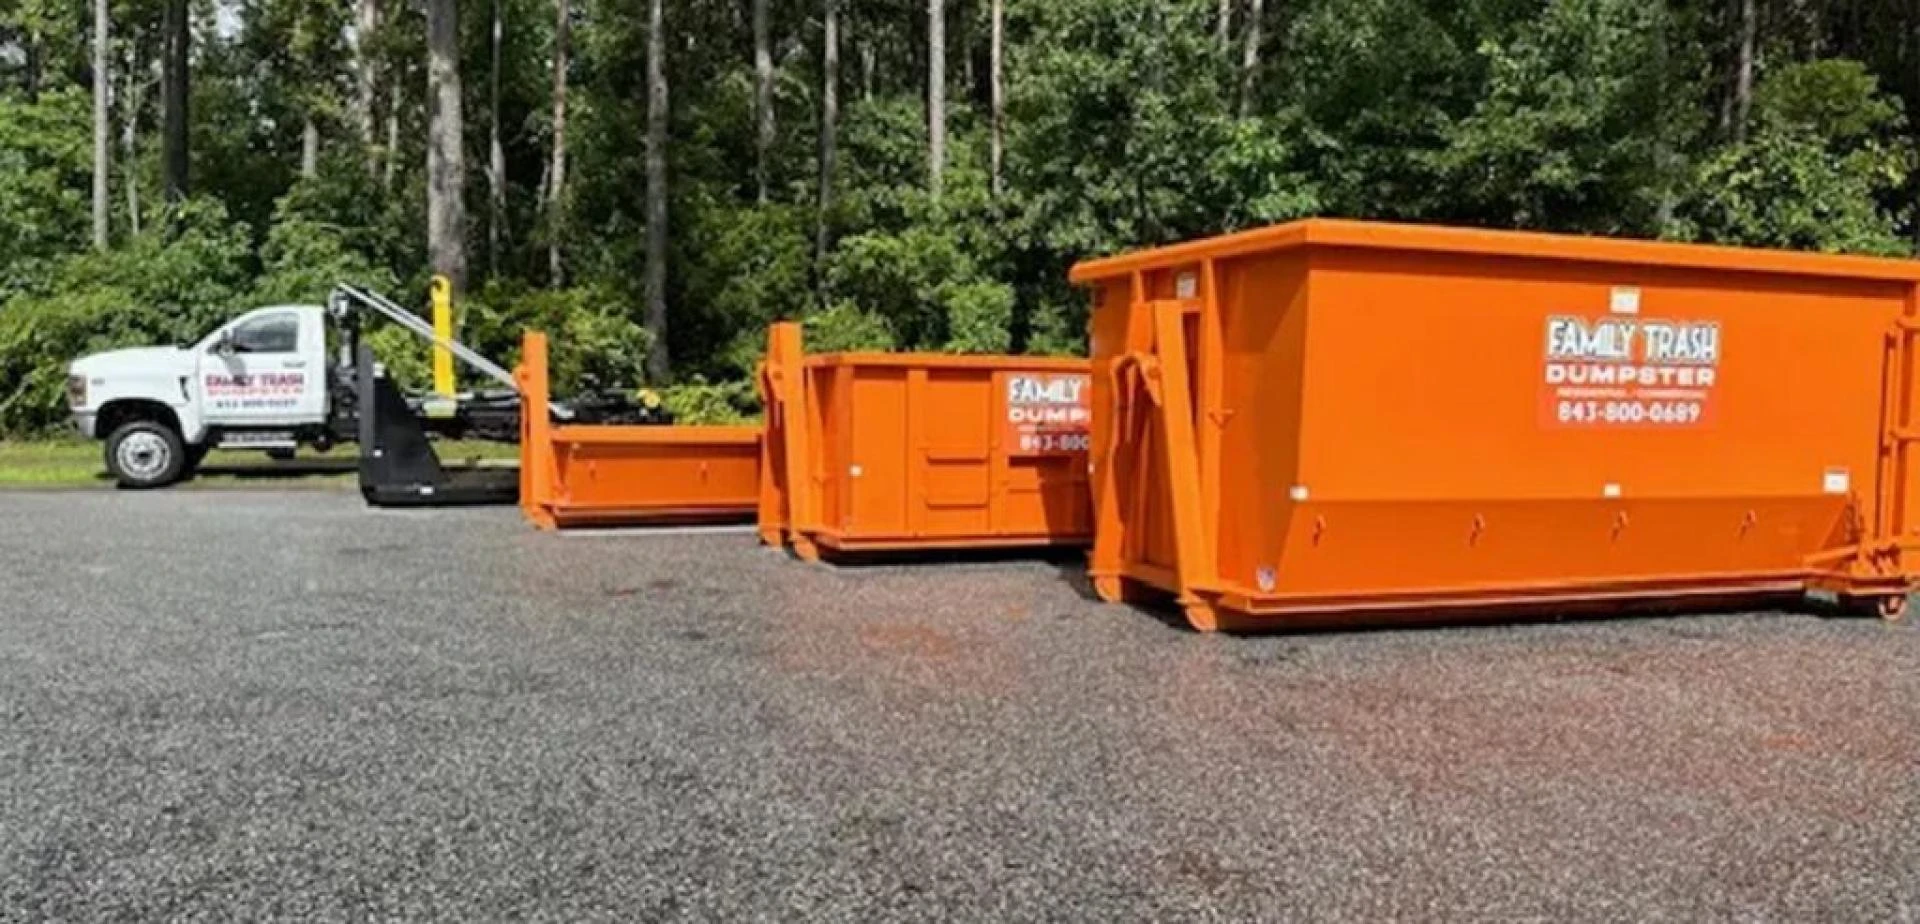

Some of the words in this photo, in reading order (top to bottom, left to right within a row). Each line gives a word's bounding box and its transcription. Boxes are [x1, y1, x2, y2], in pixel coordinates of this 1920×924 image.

[1549, 318, 1635, 358] FAMILY
[1643, 324, 1718, 361] TRASH
[1546, 364, 1716, 385] DUMPSTER
[1009, 378, 1081, 403] FAMILY
[1009, 408, 1091, 422] DUMP
[1558, 401, 1700, 422] 843-800-0689
